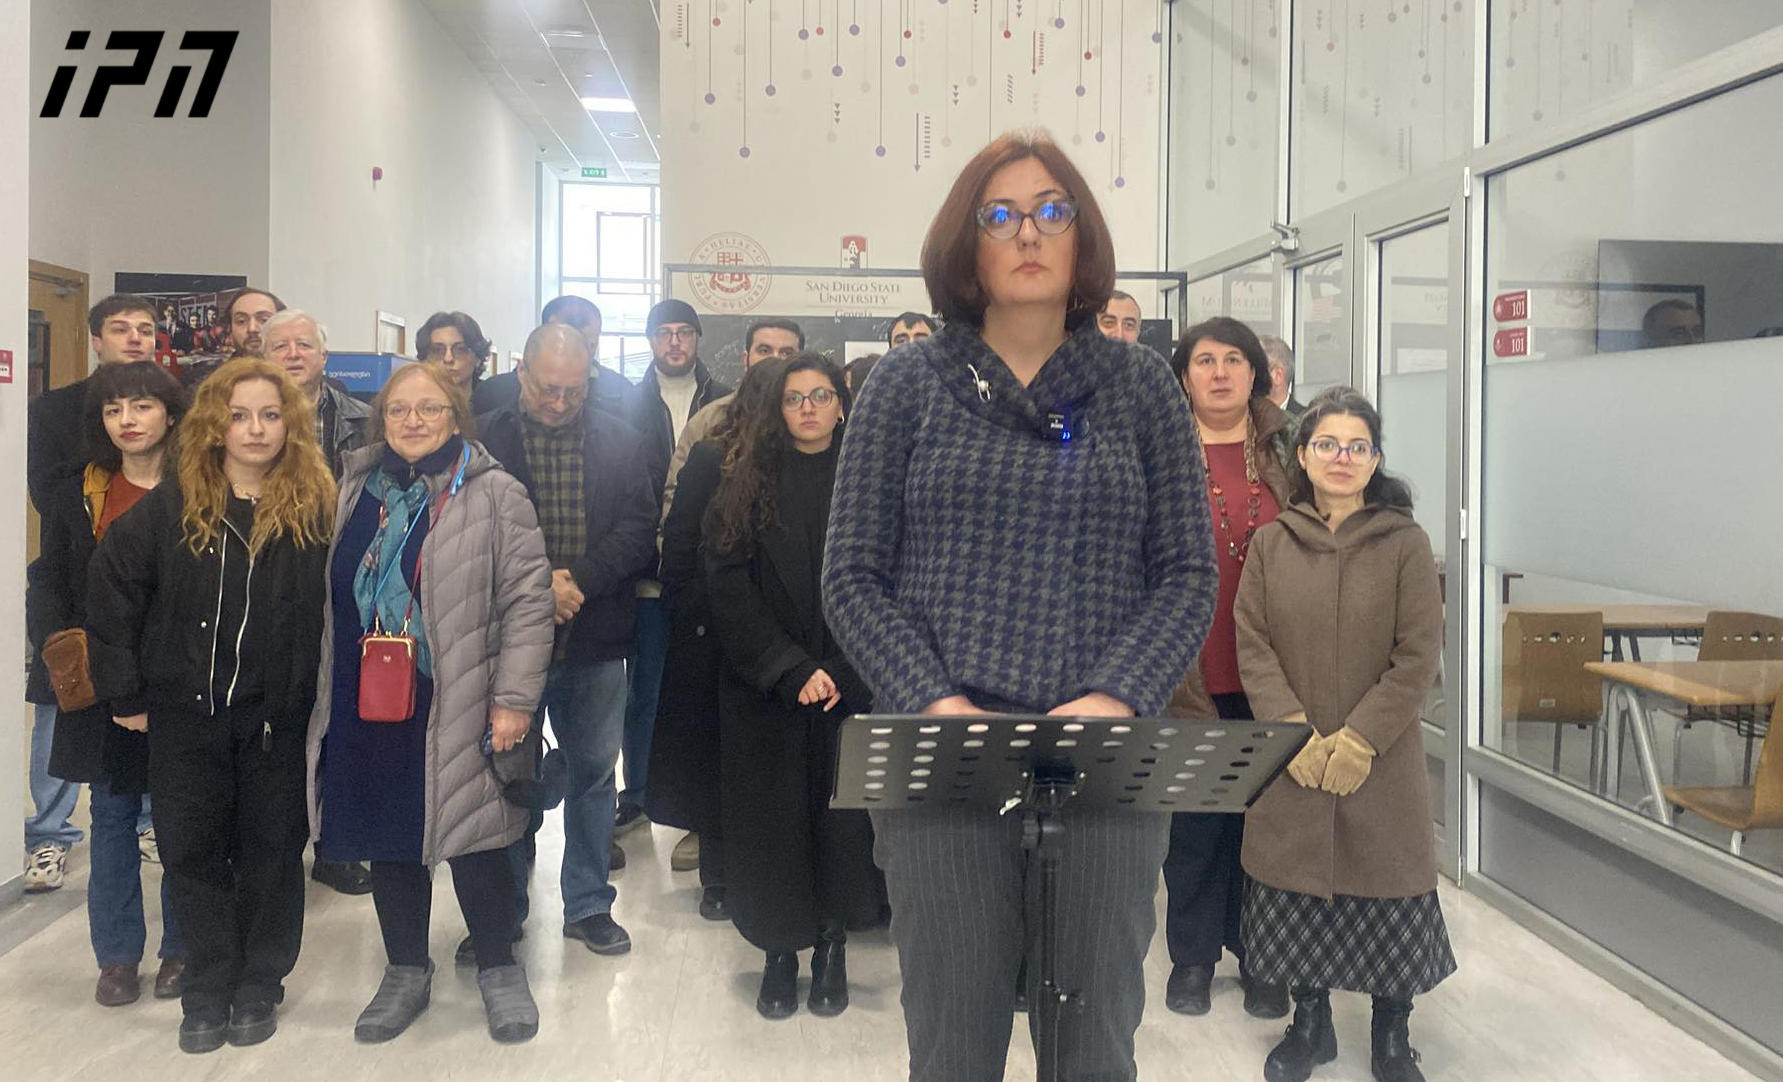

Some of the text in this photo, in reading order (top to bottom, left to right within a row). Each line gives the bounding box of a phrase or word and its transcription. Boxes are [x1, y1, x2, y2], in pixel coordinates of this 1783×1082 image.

[806, 280, 830, 293] SAN
[833, 281, 868, 293] DIEGO
[820, 293, 889, 304] UNIVERSITY
[1512, 301, 1525, 316] 101
[1512, 338, 1524, 353] 101
